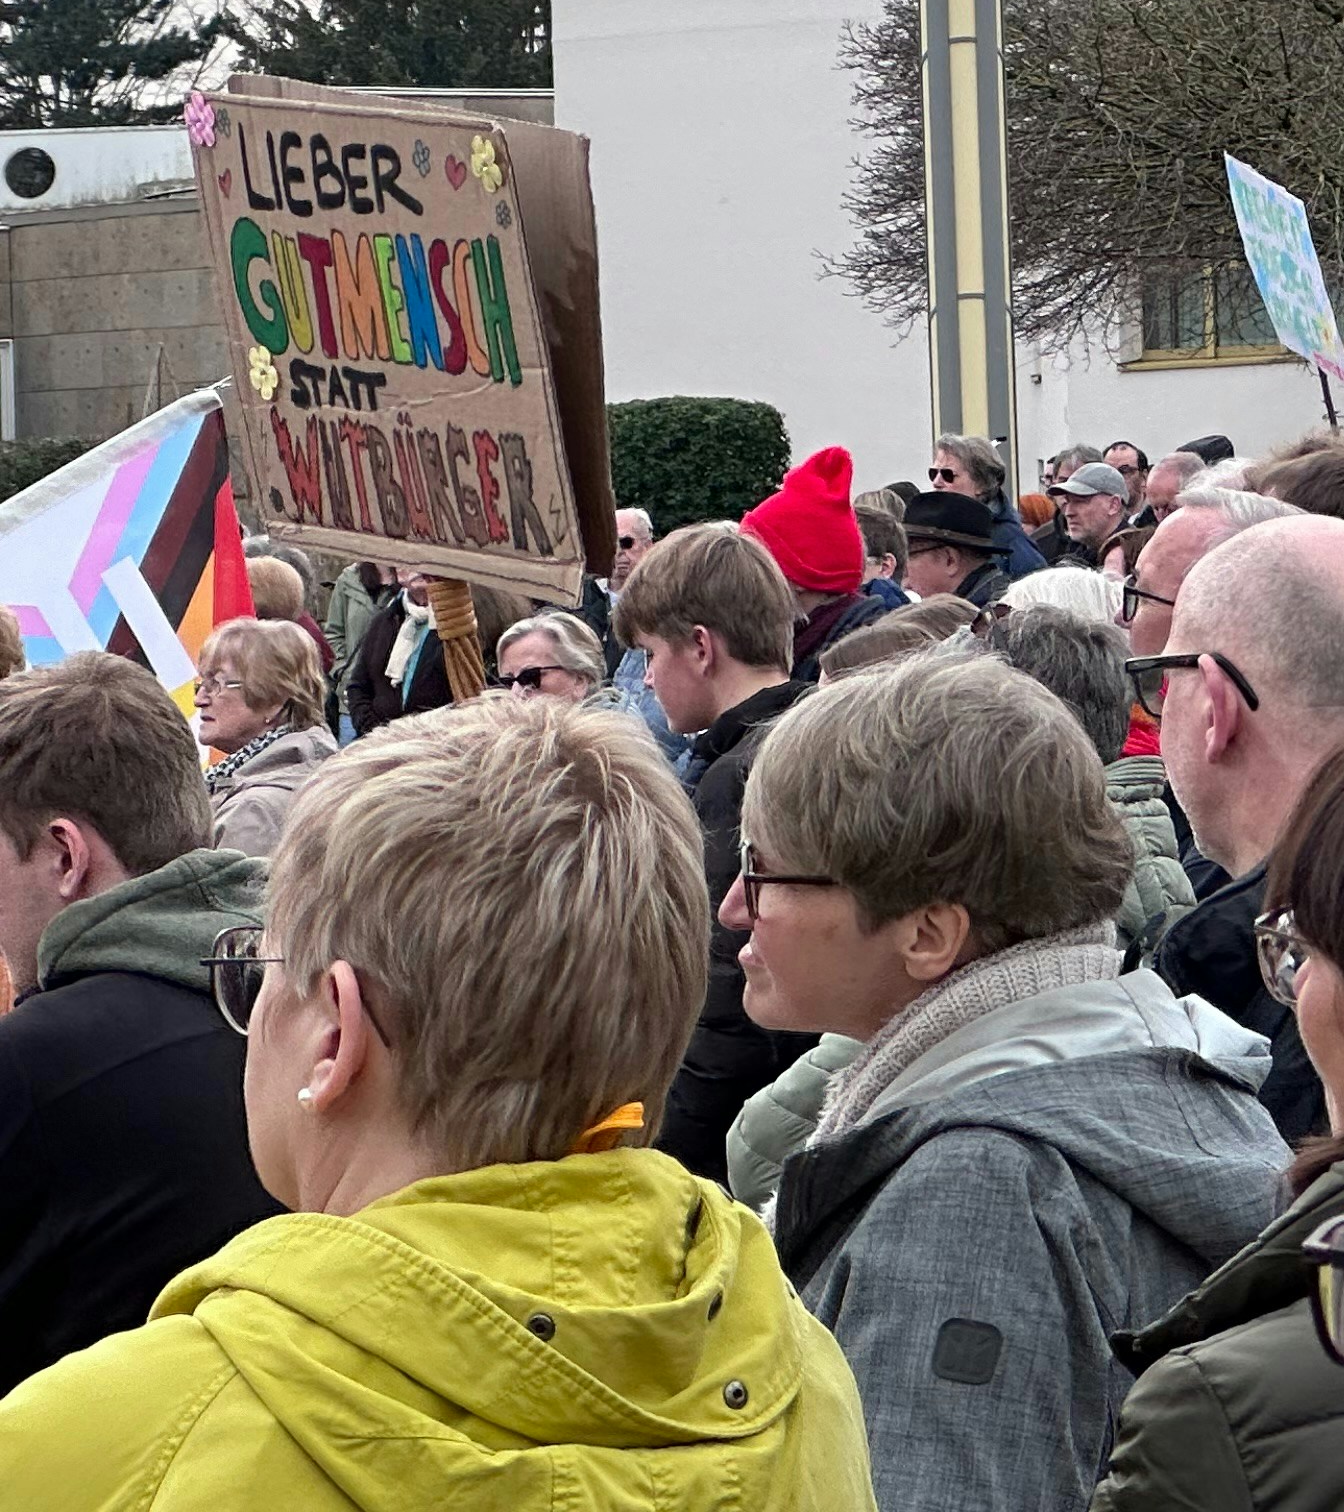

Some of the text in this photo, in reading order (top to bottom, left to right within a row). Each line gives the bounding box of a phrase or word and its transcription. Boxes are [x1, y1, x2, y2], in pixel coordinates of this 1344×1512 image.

[238, 122, 423, 216] LIEBER
[230, 217, 523, 387] GUTMENSCH
[290, 358, 386, 410] STATT
[270, 406, 553, 557] WUTBÜRGER
